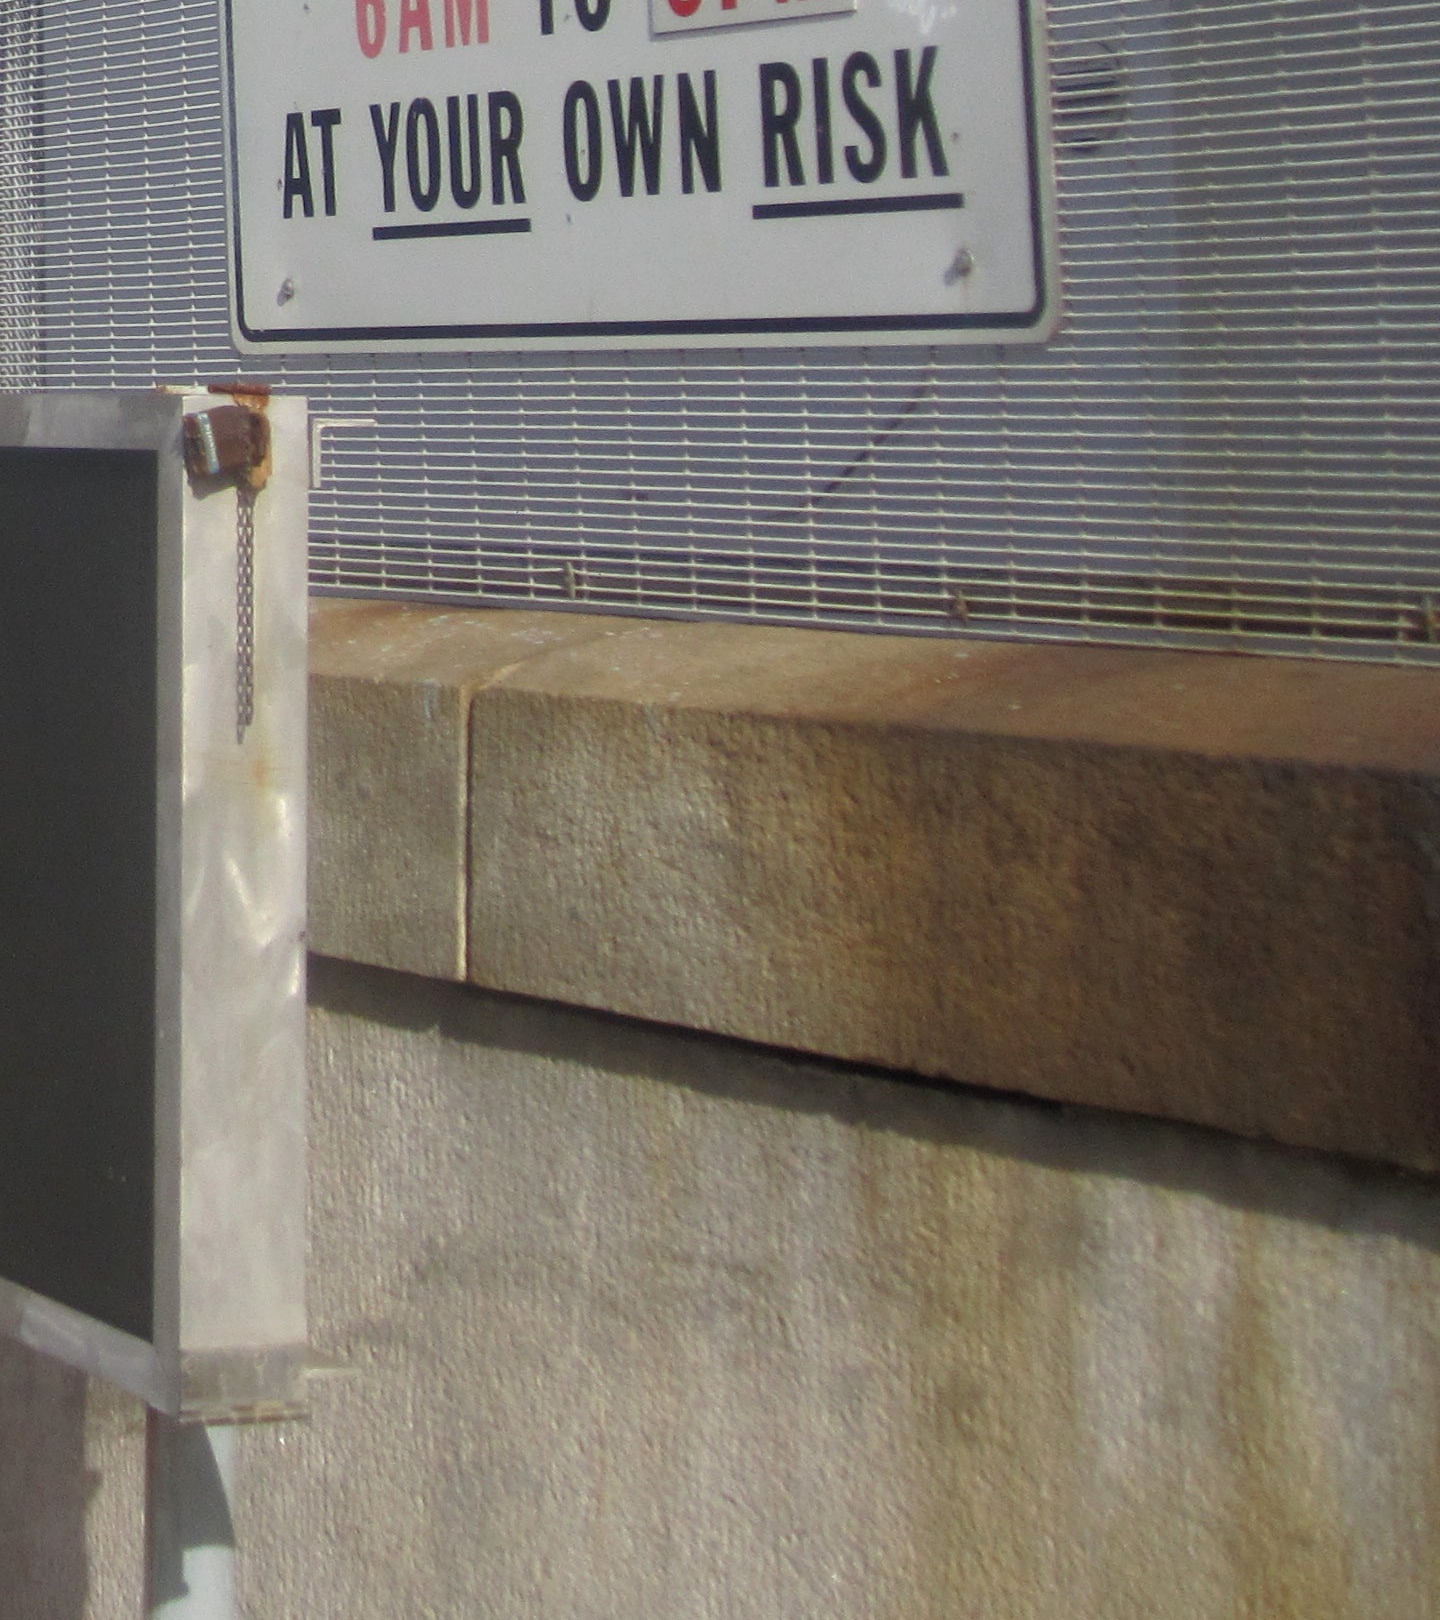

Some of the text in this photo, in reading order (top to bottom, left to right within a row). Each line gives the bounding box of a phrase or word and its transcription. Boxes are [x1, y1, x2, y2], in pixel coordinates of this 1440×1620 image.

[278, 46, 949, 219] AT YOUR OWN RISK
